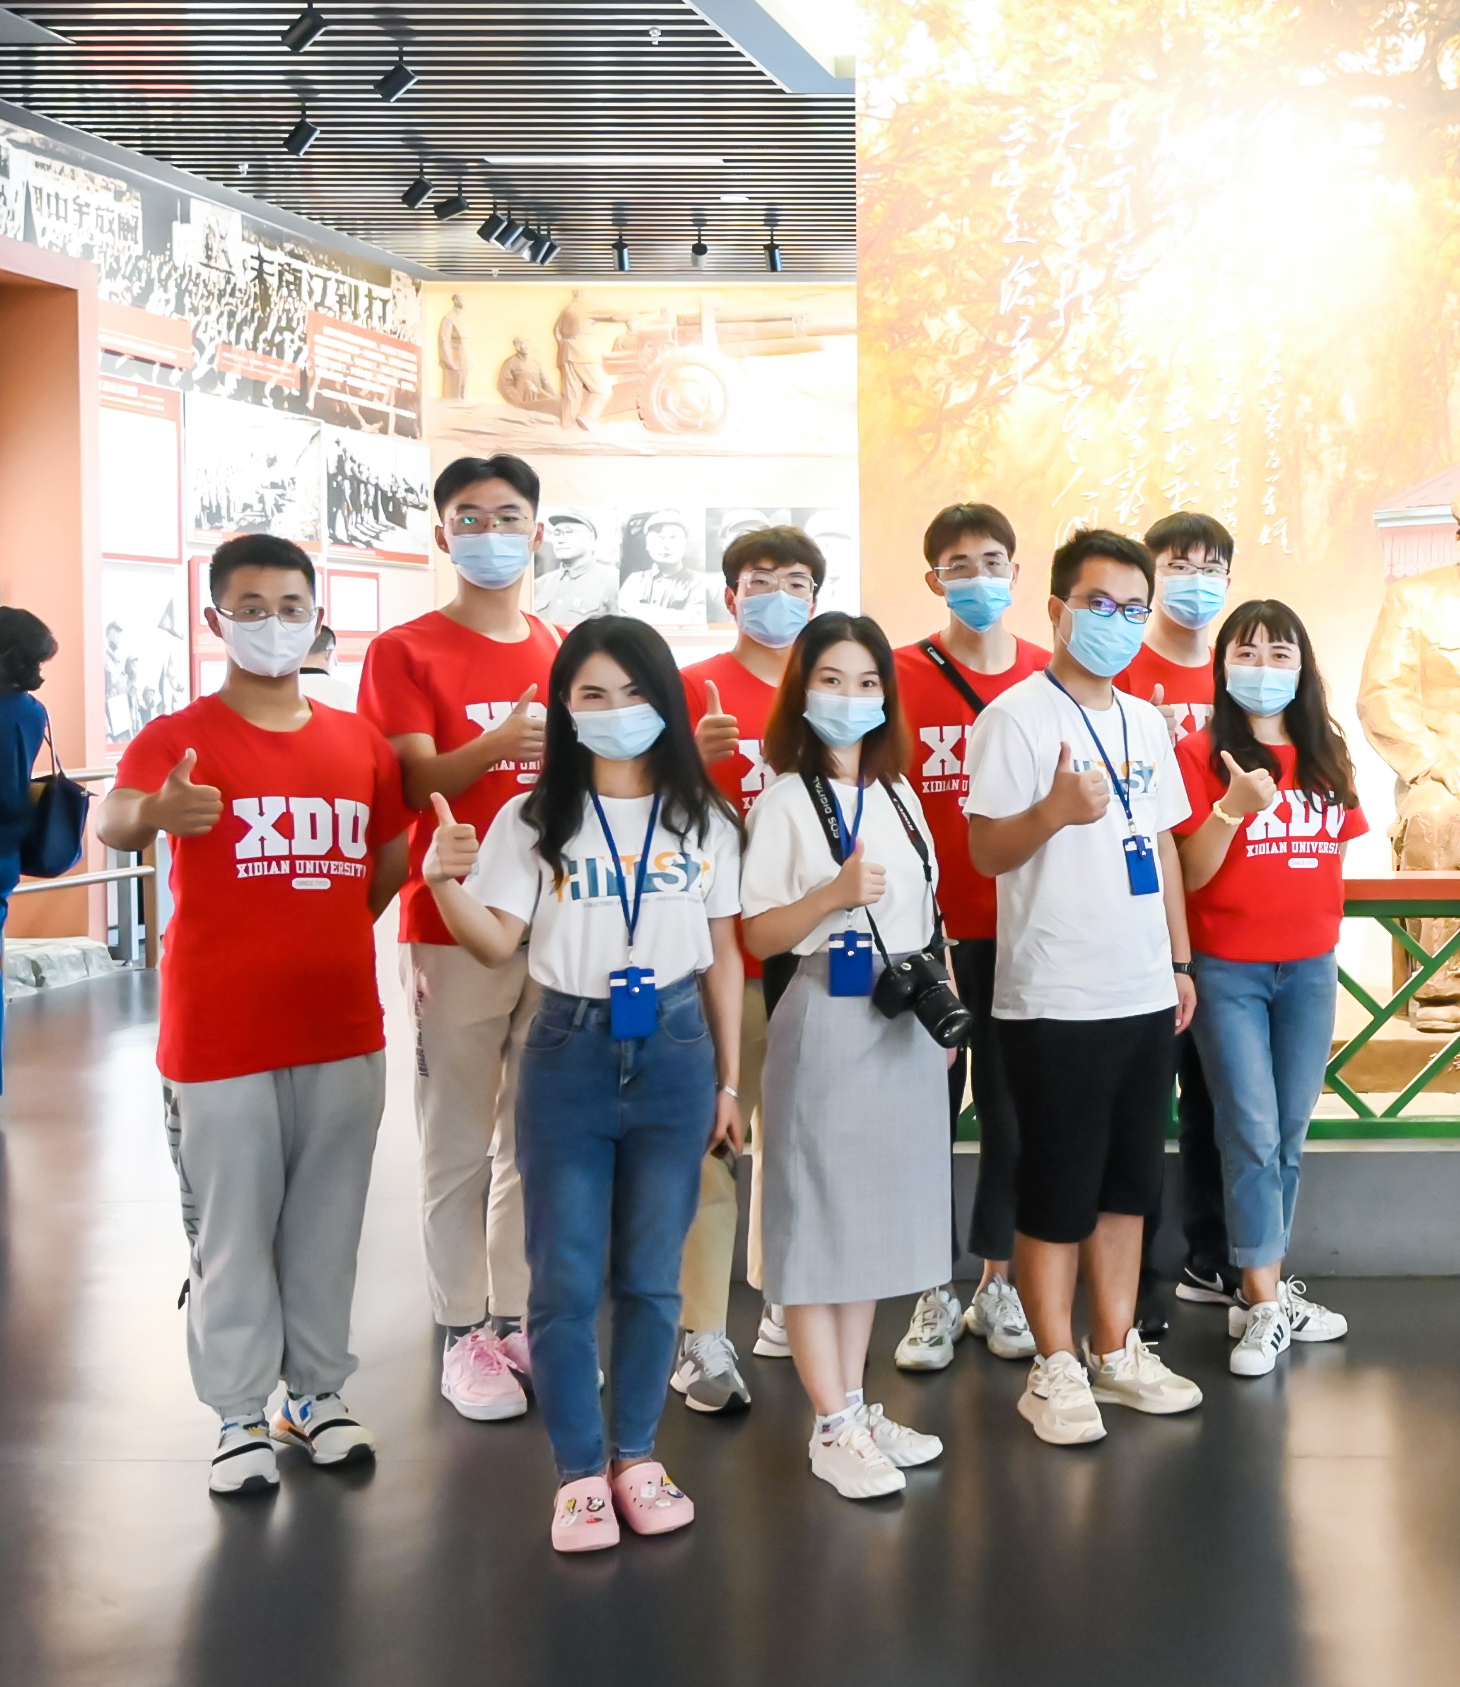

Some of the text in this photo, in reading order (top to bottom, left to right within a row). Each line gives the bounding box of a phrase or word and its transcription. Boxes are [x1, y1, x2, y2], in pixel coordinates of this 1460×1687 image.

[232, 796, 370, 859] XDU
[1246, 842, 1287, 857] XIDIAN
[236, 860, 290, 879] XIDIAN
